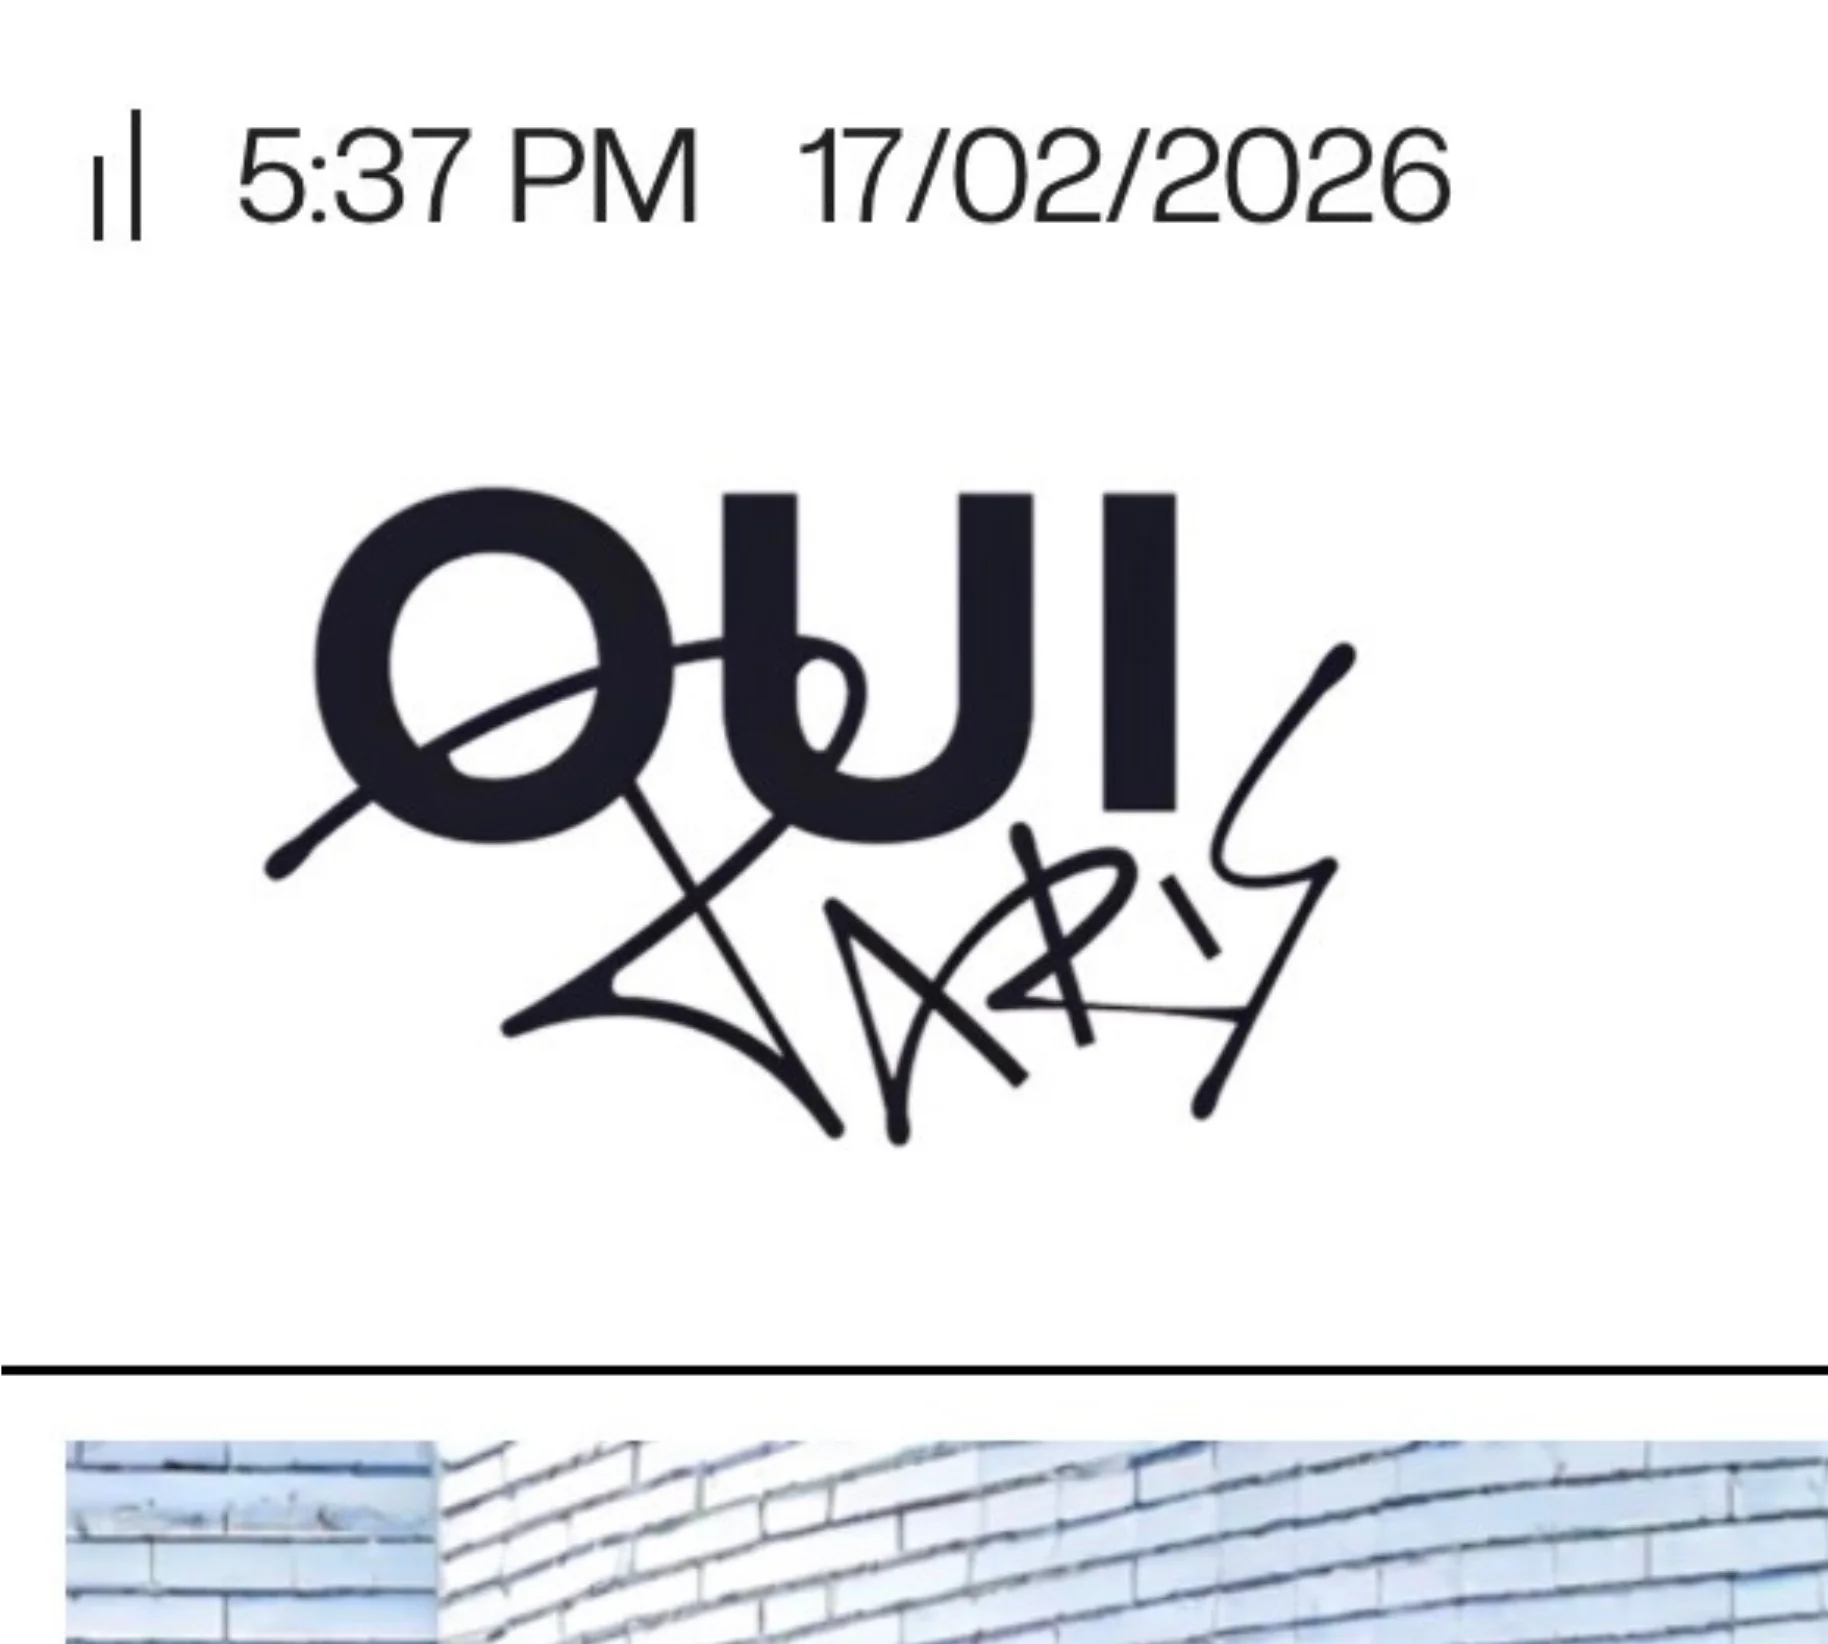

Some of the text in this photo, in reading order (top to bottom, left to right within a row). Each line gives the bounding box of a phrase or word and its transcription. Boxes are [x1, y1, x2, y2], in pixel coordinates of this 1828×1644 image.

[240, 125, 1451, 225] 5:37 PM 17/02/2026
[315, 487, 1177, 843] OUI
